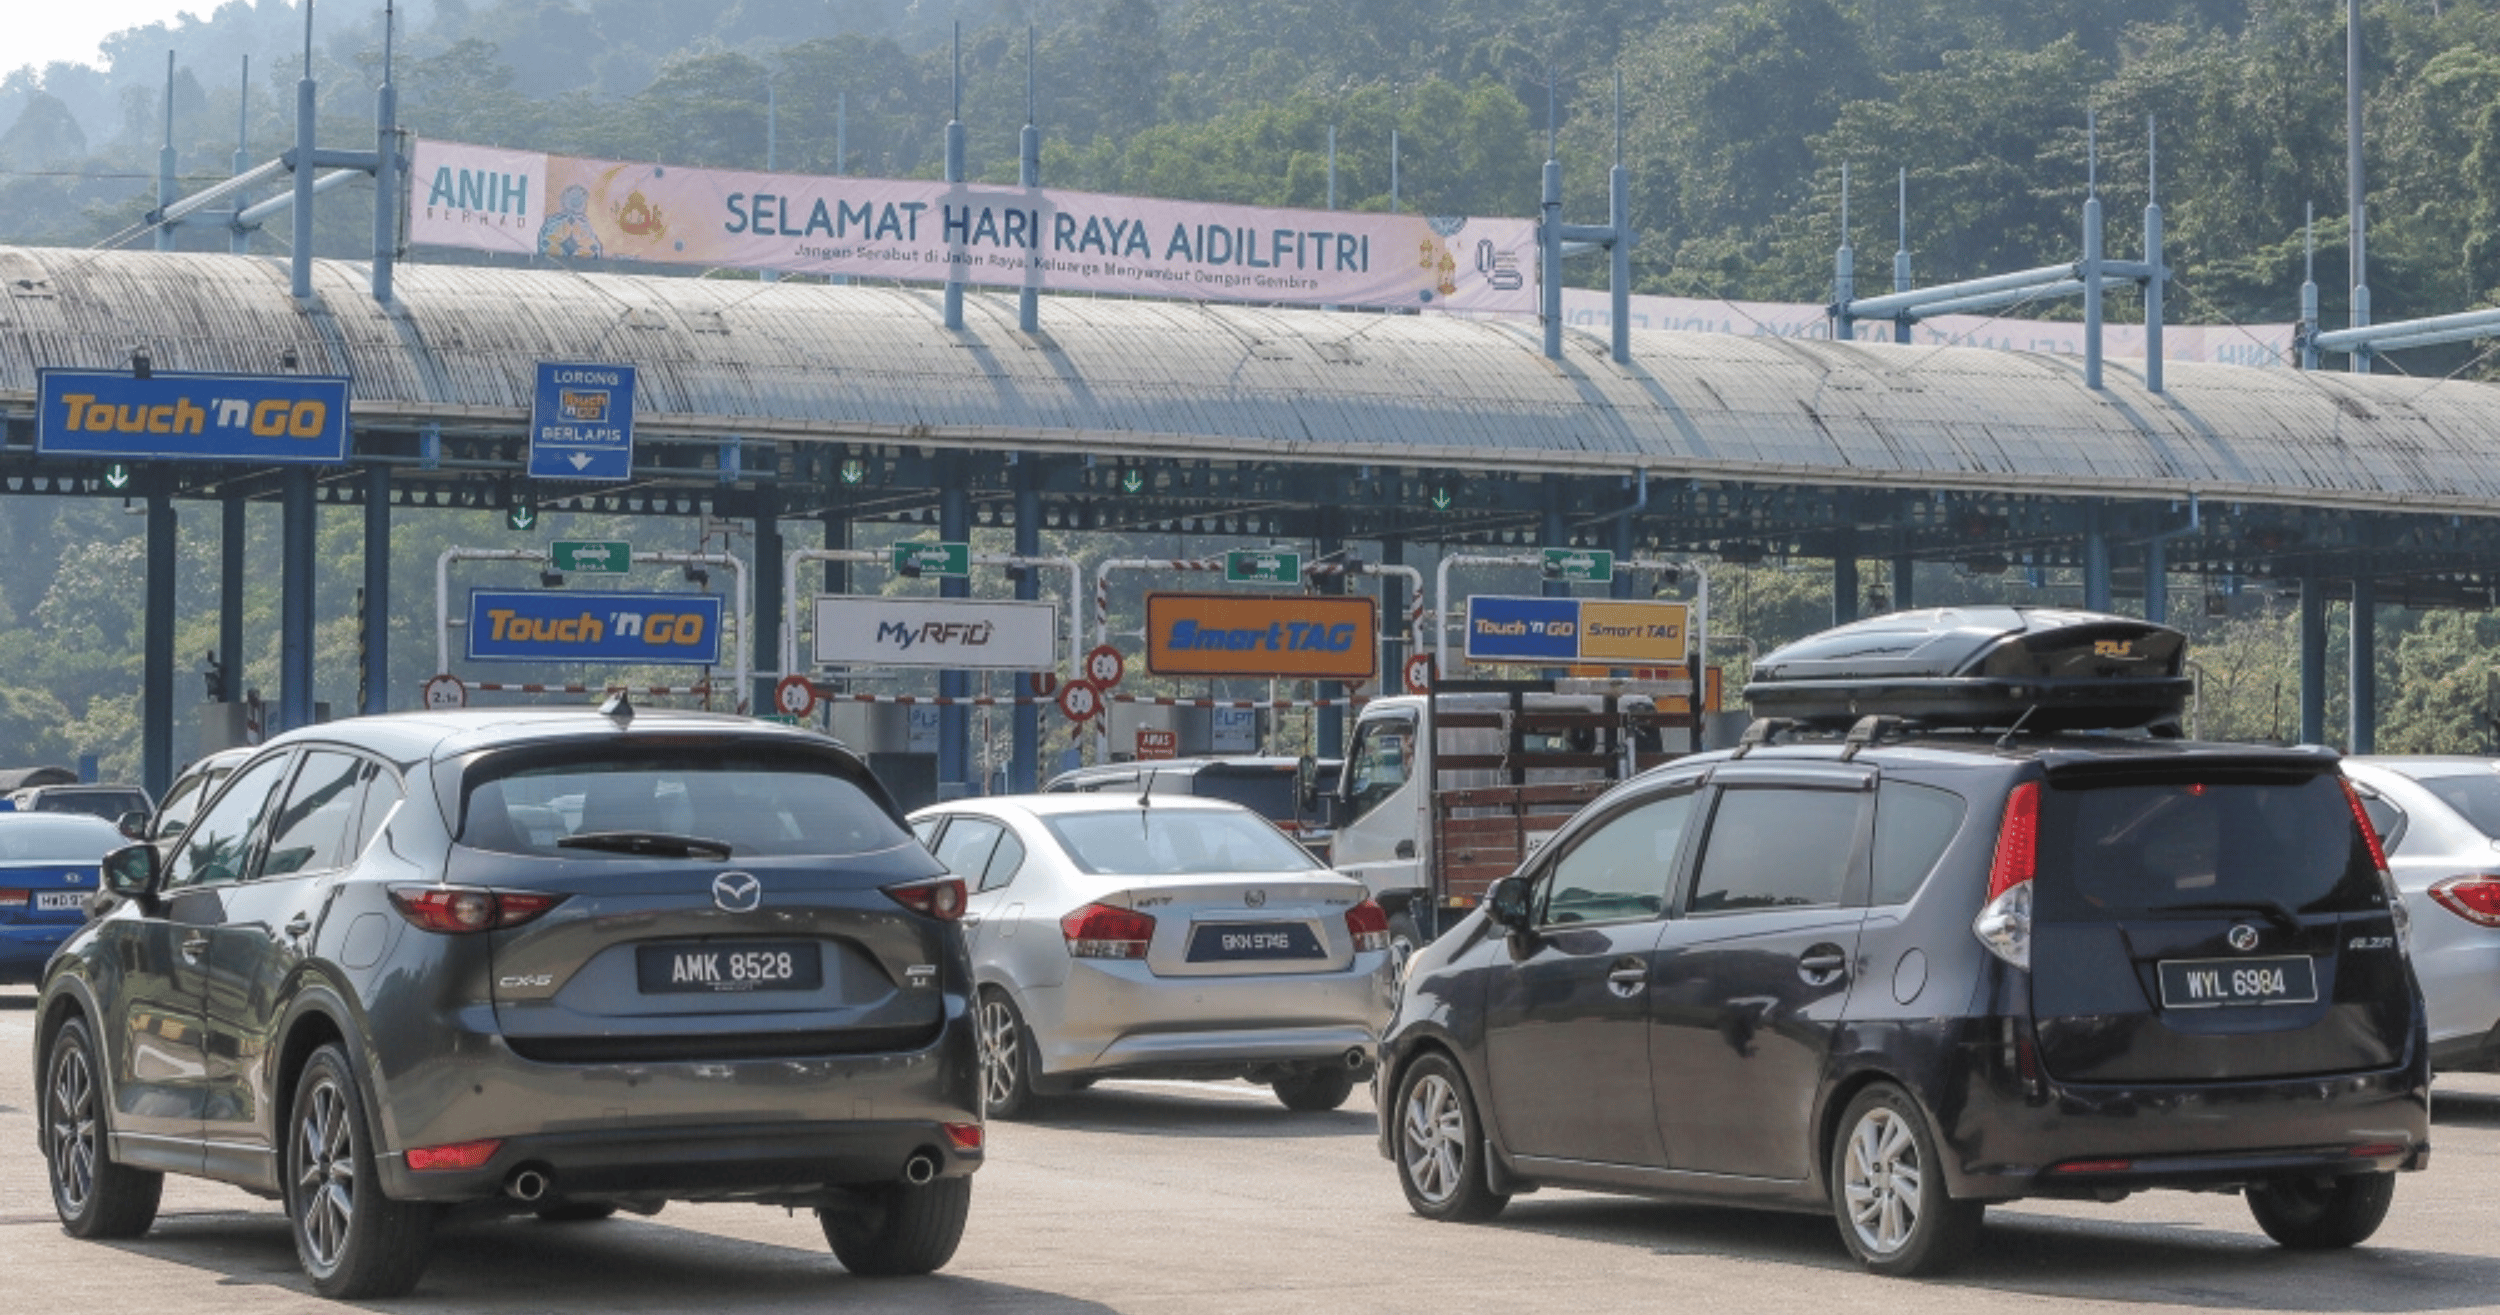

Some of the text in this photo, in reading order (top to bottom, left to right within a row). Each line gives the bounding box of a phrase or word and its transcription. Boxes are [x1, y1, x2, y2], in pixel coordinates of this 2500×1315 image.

[428, 165, 528, 216] ANIH
[725, 192, 1369, 273] SELAMAT HARI RAYA AIDILFITRI
[795, 244, 851, 261] Jangan
[857, 246, 919, 262] Serabut
[924, 249, 939, 263] di
[942, 251, 984, 266] Jalan
[1034, 257, 1099, 276] Keluarga
[1104, 262, 1191, 281] Menyambut
[1195, 269, 1251, 288] Dengan
[1255, 274, 1319, 290] Gembira
[553, 369, 619, 386] LORONG
[62, 394, 206, 435] Touch
[251, 399, 327, 438] GO
[541, 426, 622, 441] BERLAPIS
[487, 609, 604, 643] Touch
[643, 613, 705, 646] GO
[1475, 618, 1528, 636] Touch
[1546, 620, 1576, 637] GO
[1587, 622, 1680, 639] Smart TAG
[499, 974, 554, 988] CX-5
[672, 951, 794, 983] AMK 8528
[2186, 966, 2286, 998] WYL 6984
